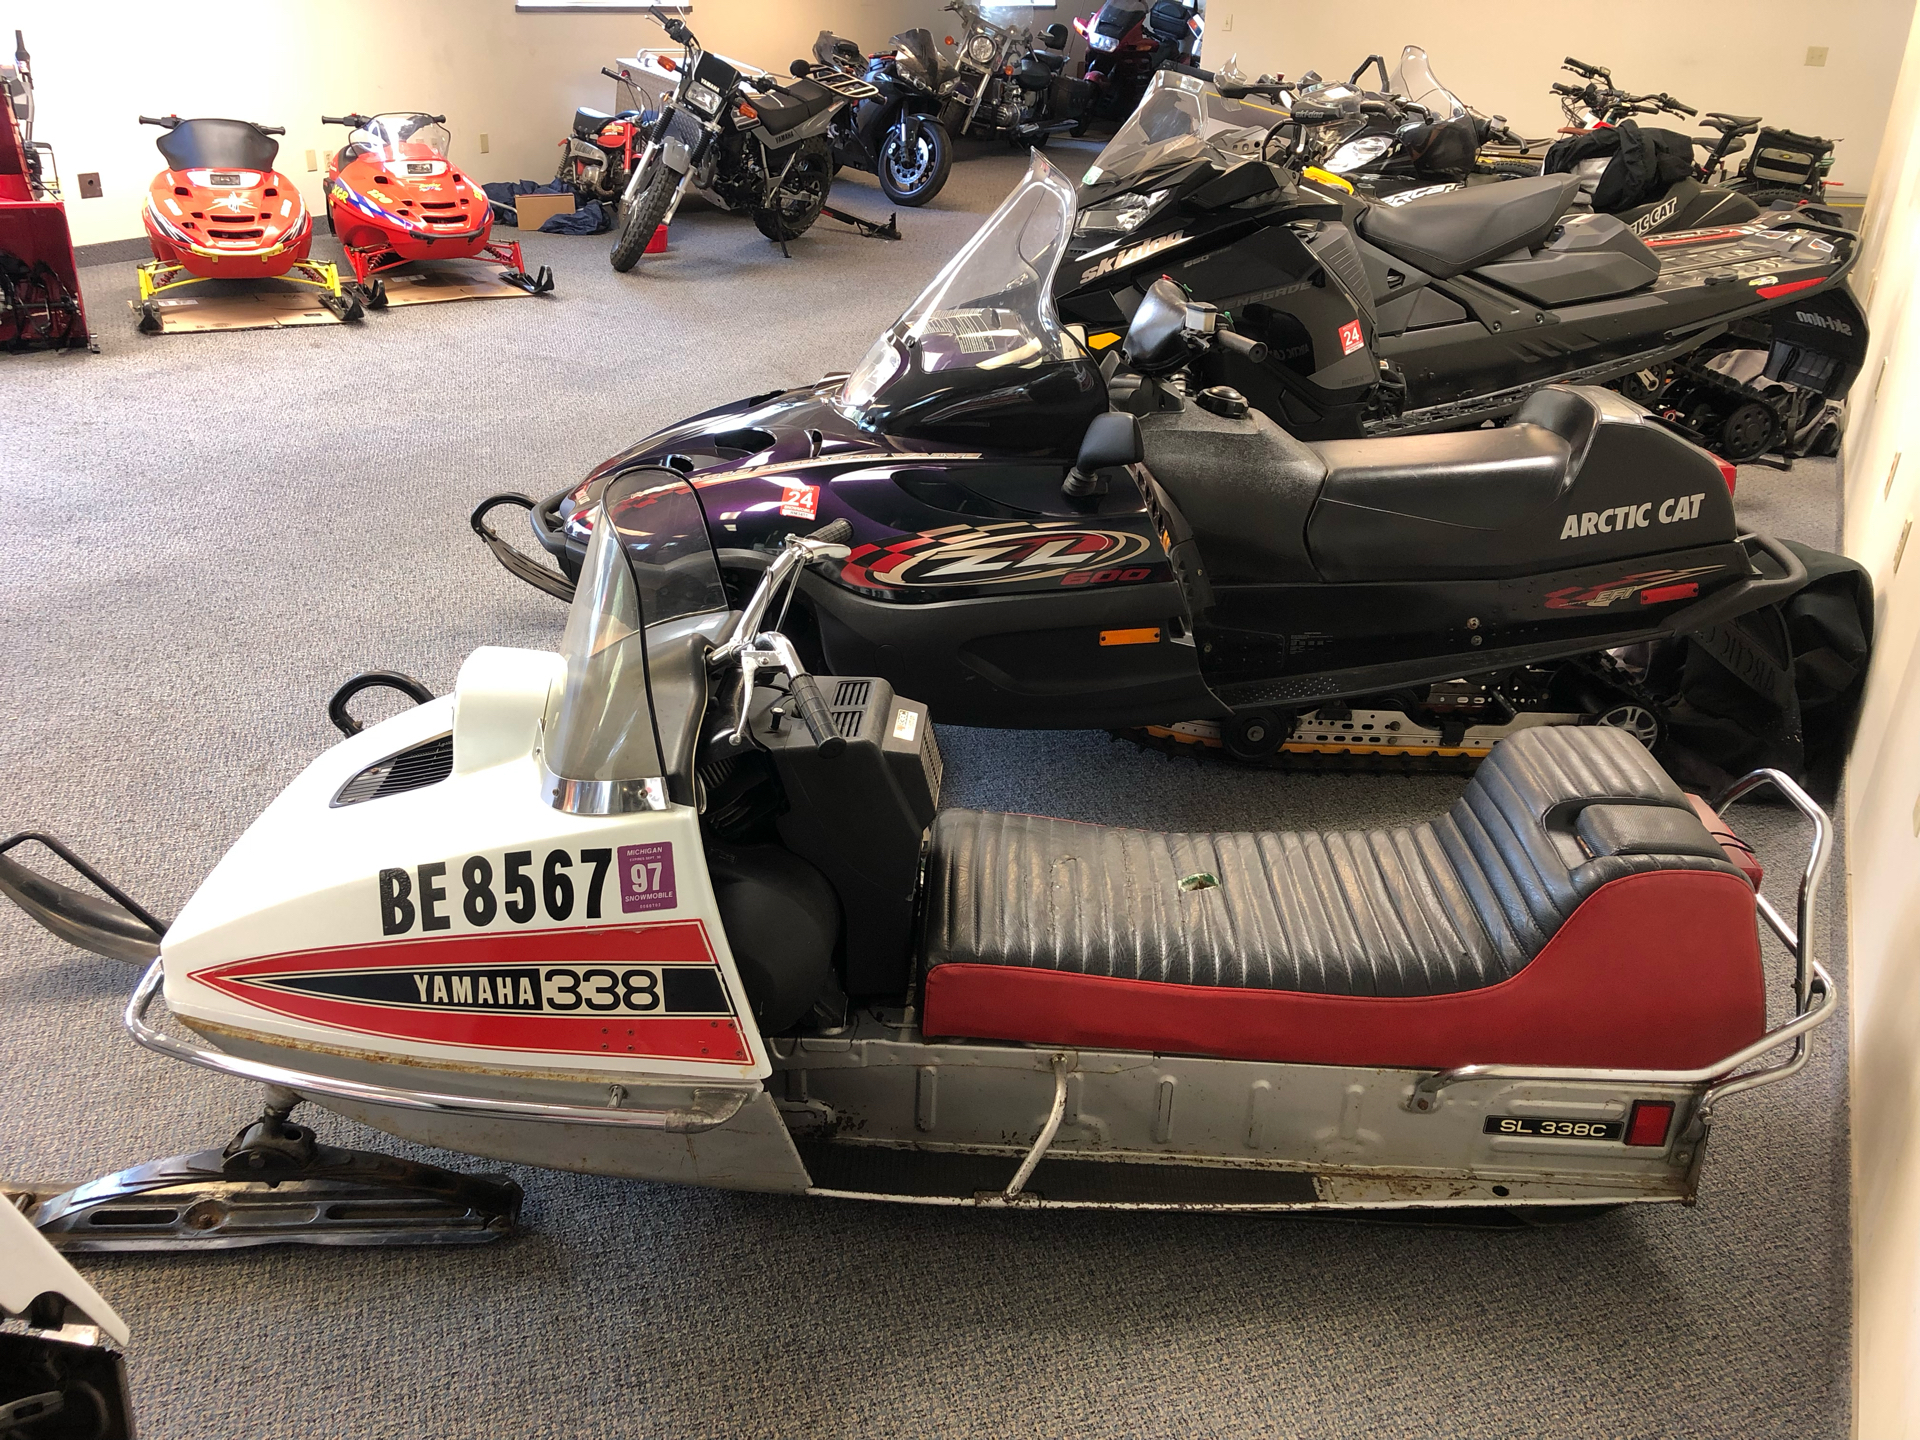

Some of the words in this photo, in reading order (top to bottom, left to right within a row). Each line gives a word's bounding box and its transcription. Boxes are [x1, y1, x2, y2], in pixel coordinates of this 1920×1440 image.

[701, 78, 720, 93] YAMAHA
[775, 130, 794, 144] YAMAHA
[1650, 196, 1678, 226] CAT
[1343, 327, 1360, 346] 24
[788, 490, 814, 508] 24
[1559, 501, 1653, 541] ARCTIC
[1658, 493, 1706, 525] CAT
[1059, 568, 1151, 586] 600
[1593, 585, 1637, 604] EFI
[626, 846, 663, 857] MICHIGAN
[630, 861, 663, 893] 97
[379, 861, 451, 936] BE
[461, 847, 613, 927] 8567
[624, 890, 673, 903] SNOWMOBILE
[413, 974, 536, 1005] YAMAHA
[544, 968, 661, 1011] 338
[1499, 1119, 1533, 1134] SL
[1539, 1120, 1607, 1137] 338C
